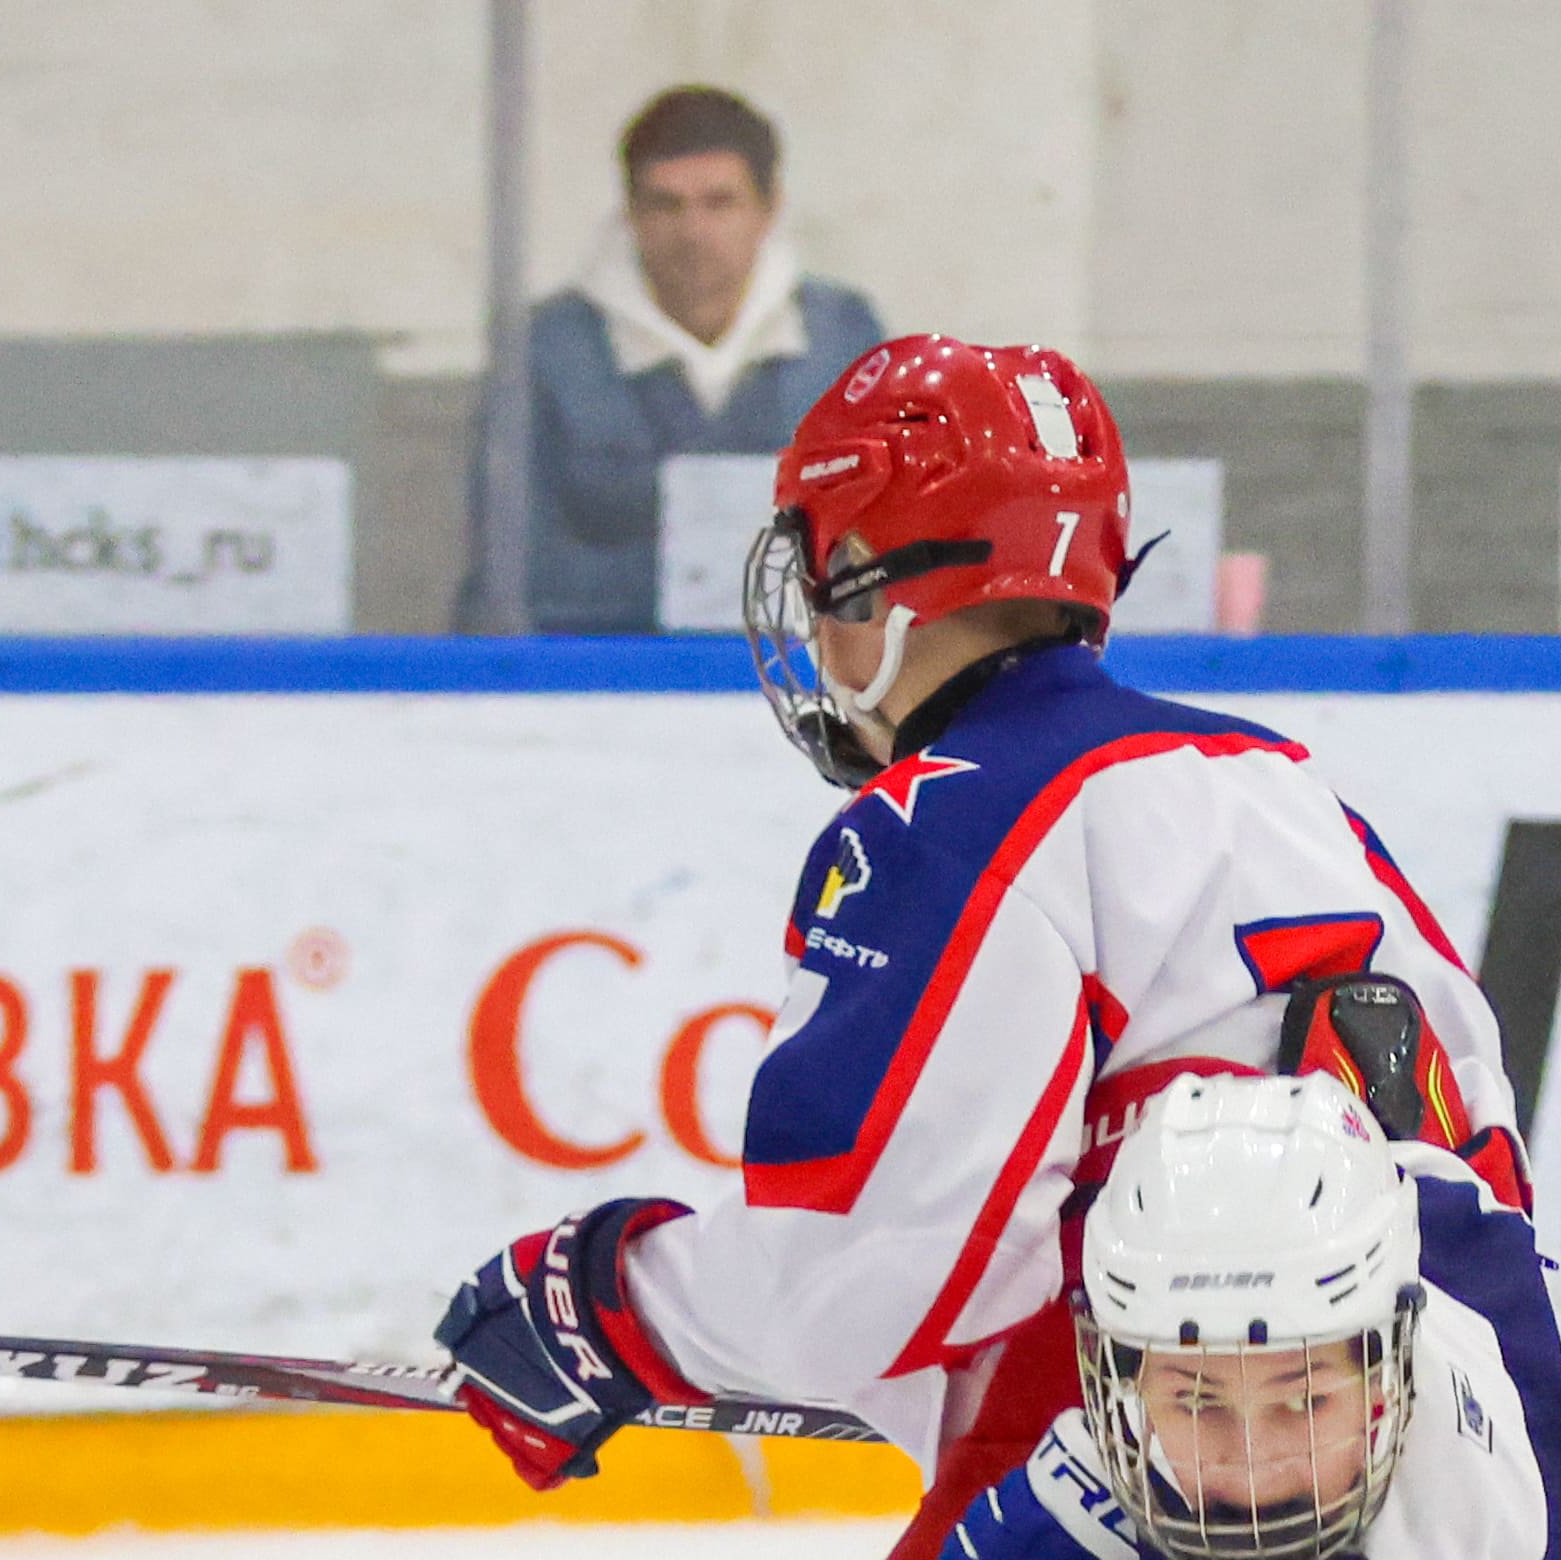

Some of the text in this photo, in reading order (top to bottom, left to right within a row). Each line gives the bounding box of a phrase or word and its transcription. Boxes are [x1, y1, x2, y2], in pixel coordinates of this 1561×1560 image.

[8, 506, 276, 590] hcks_ru
[1048, 510, 1080, 577] 7
[731, 1410, 804, 1435] JNR
